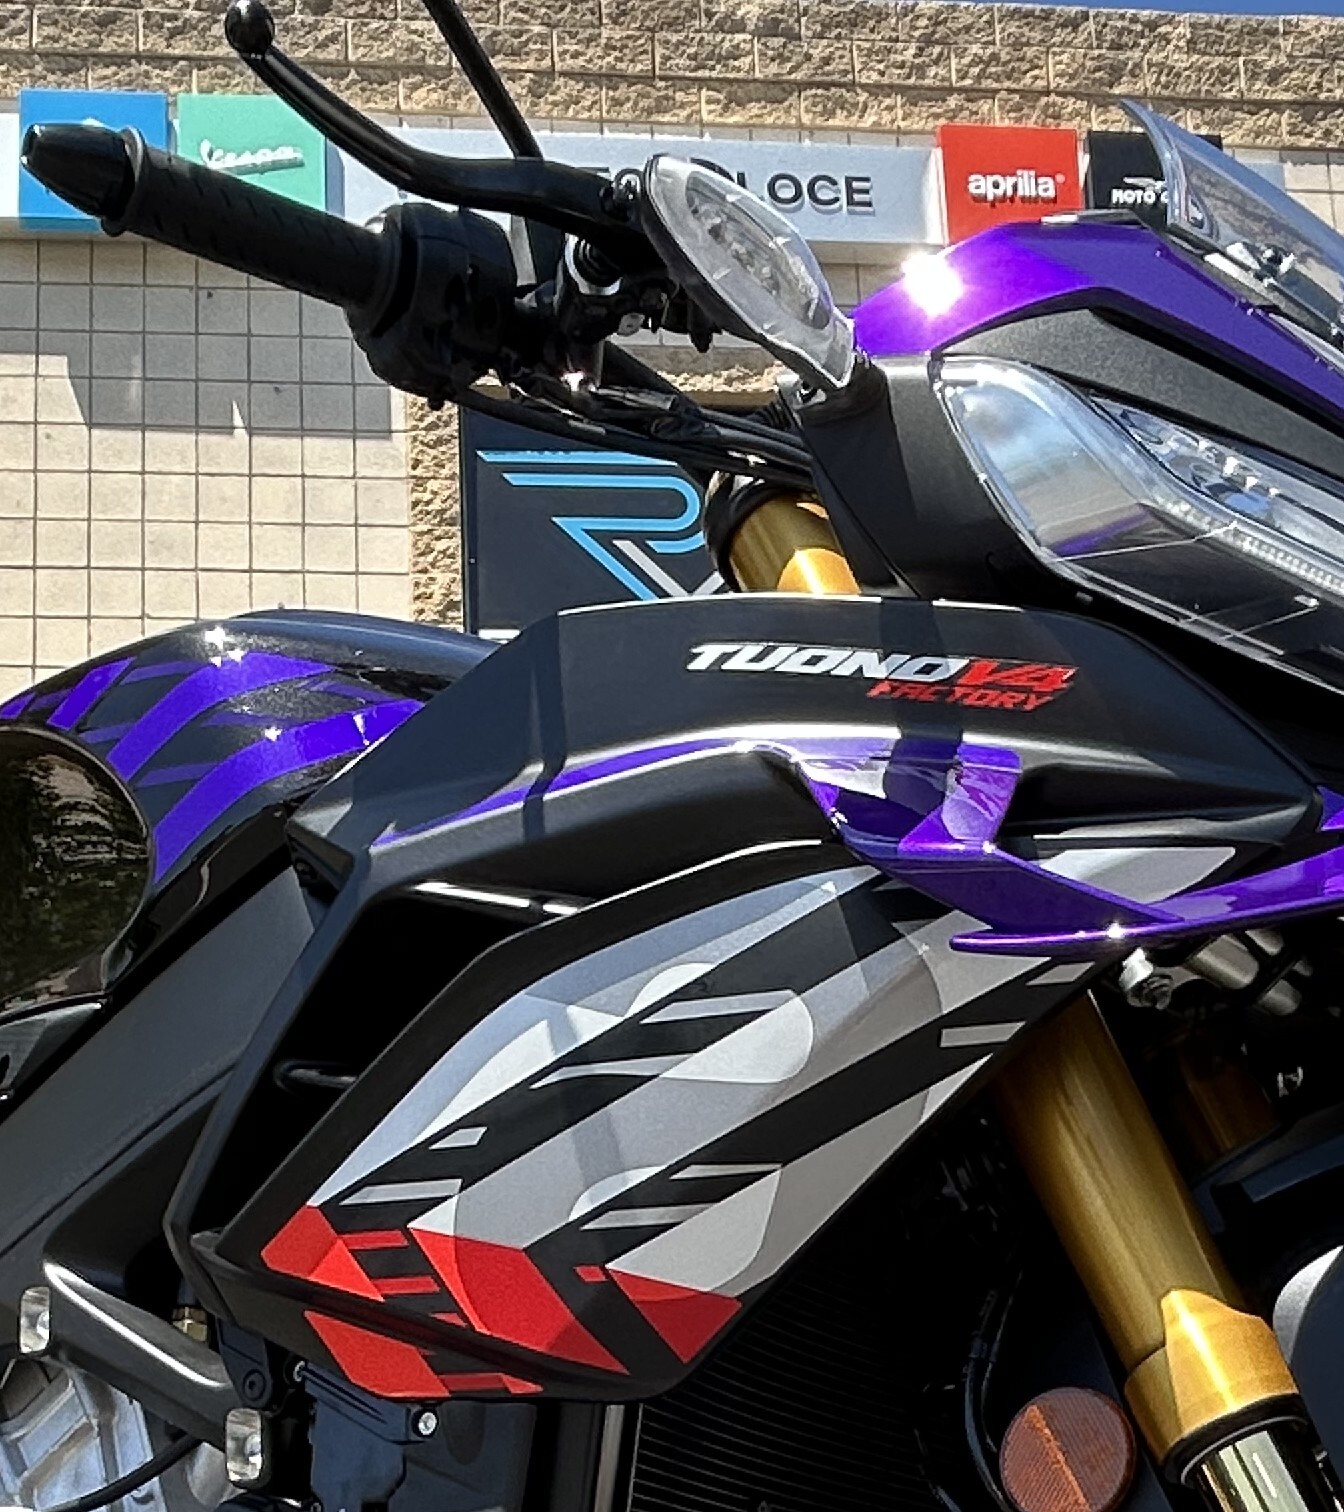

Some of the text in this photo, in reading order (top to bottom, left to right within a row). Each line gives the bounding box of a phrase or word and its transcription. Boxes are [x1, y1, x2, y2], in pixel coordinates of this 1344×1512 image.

[967, 168, 1057, 200] aprilia
[1111, 188, 1156, 204] MOTO
[686, 641, 1079, 693] TUONO V4
[866, 681, 1055, 712] FACTORY
